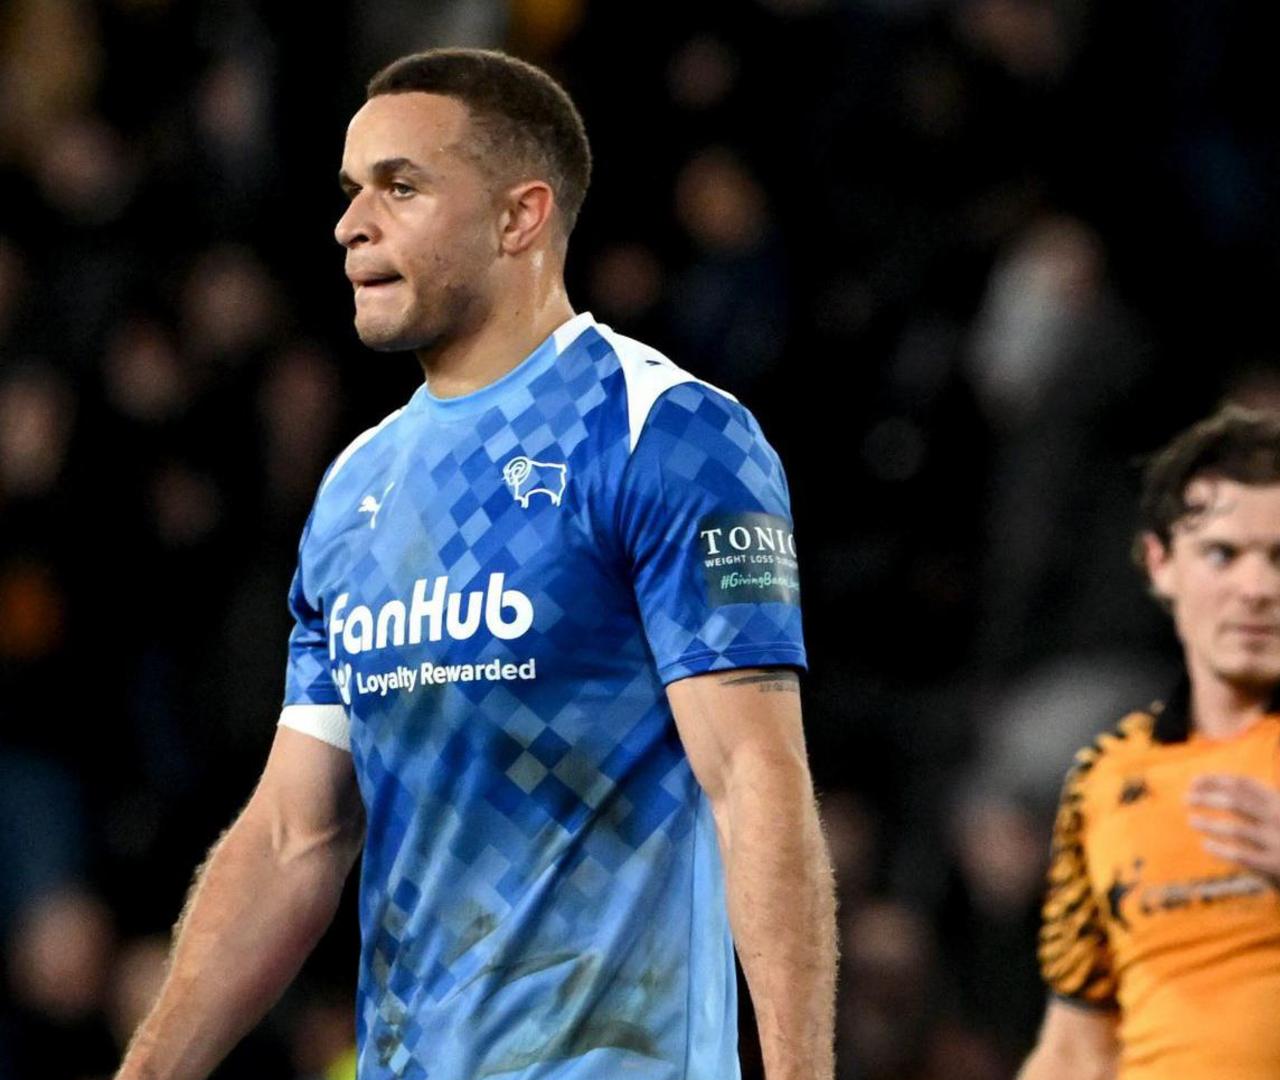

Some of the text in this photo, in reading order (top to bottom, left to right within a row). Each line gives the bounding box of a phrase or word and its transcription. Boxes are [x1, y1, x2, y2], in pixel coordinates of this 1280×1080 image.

[704, 554, 747, 568] WEIGHT
[750, 555, 774, 564] LOSS
[356, 658, 536, 696] Loyalty Rewarded
